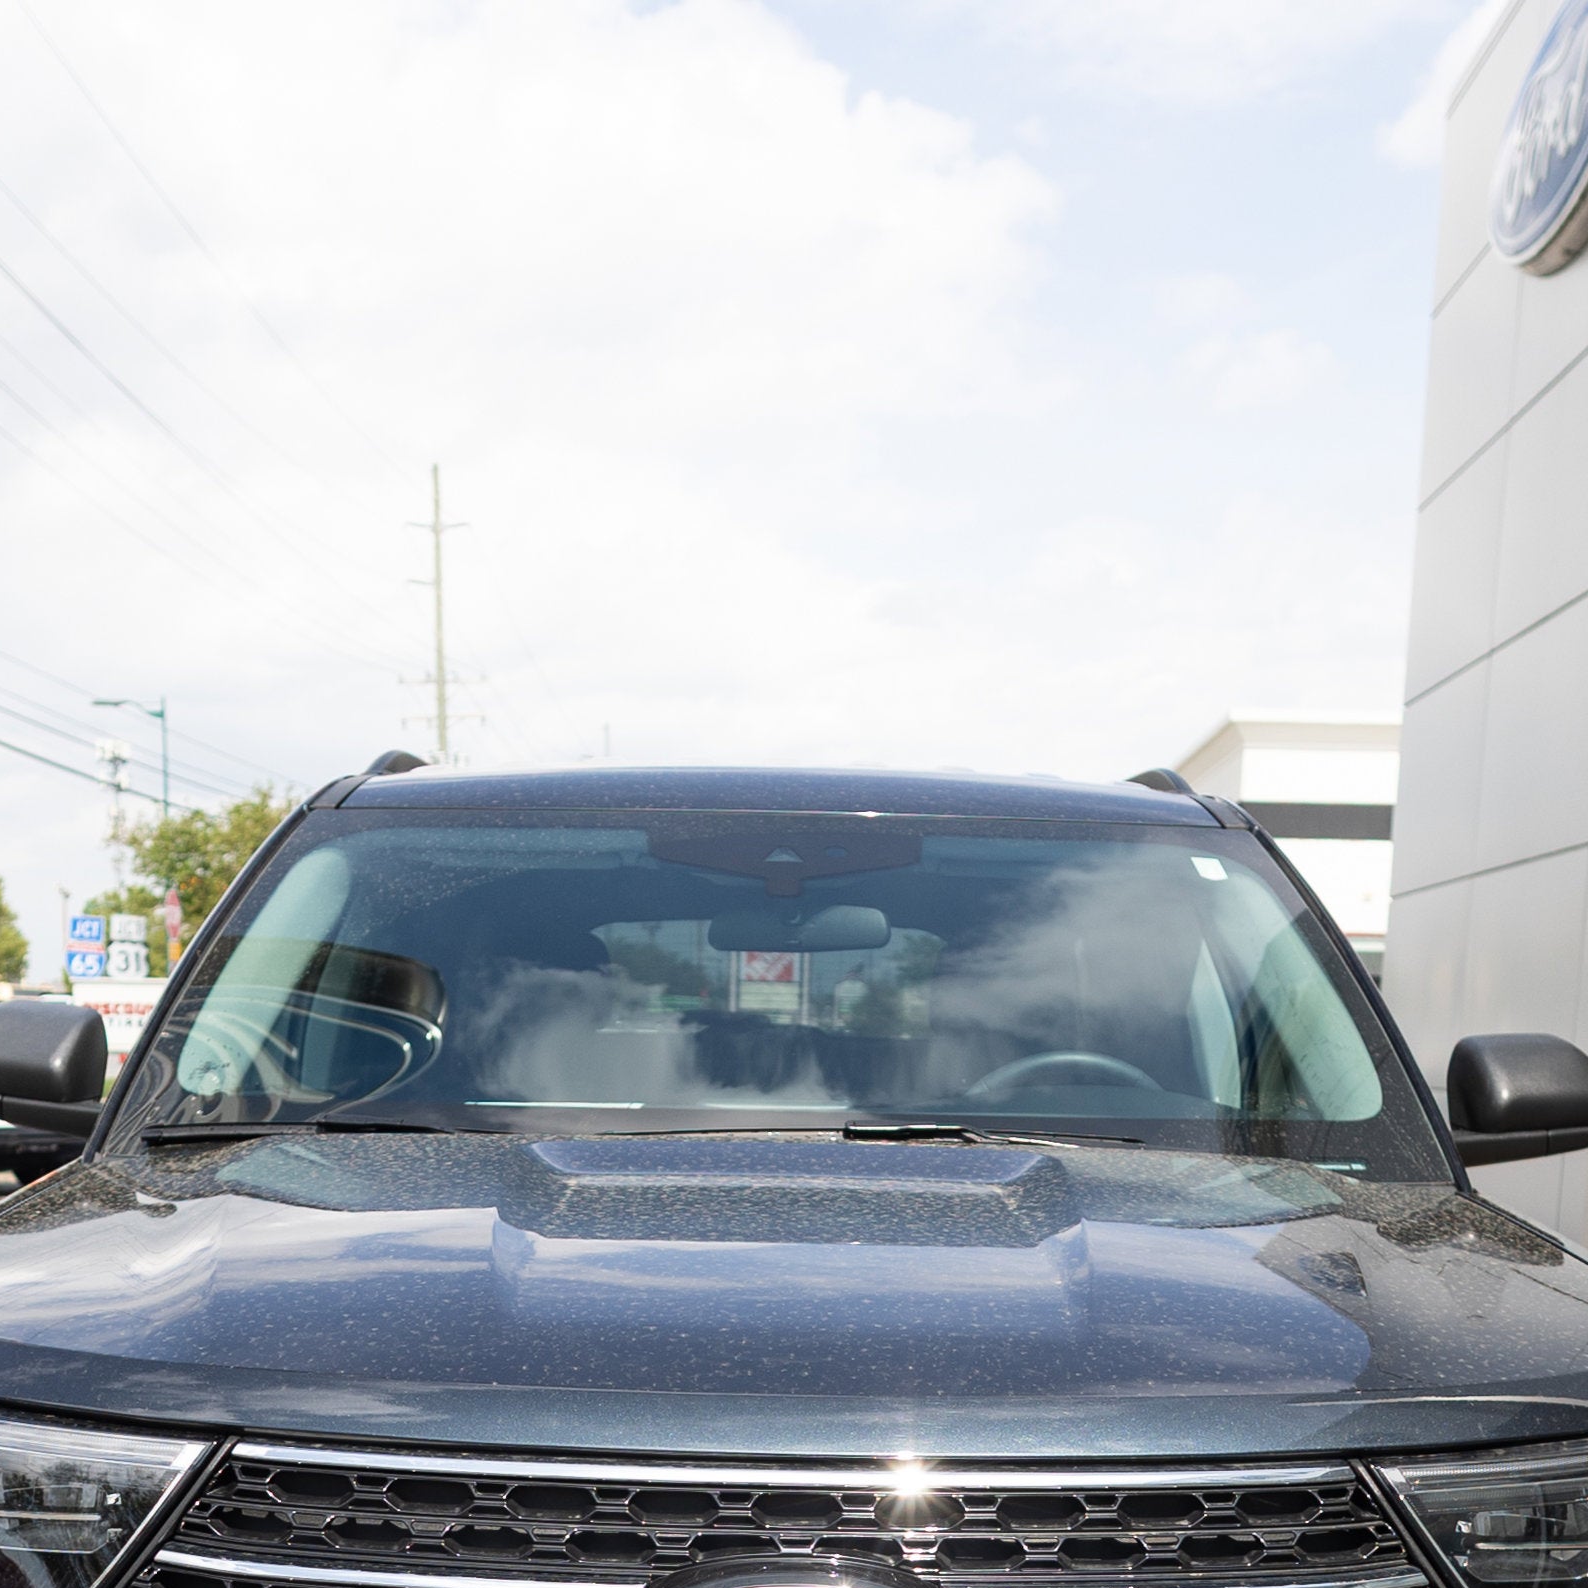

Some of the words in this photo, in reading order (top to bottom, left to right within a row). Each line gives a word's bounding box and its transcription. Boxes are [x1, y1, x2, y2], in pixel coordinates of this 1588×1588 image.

[73, 919, 100, 937] JCT
[70, 953, 100, 976] 65
[117, 950, 141, 972] 31
